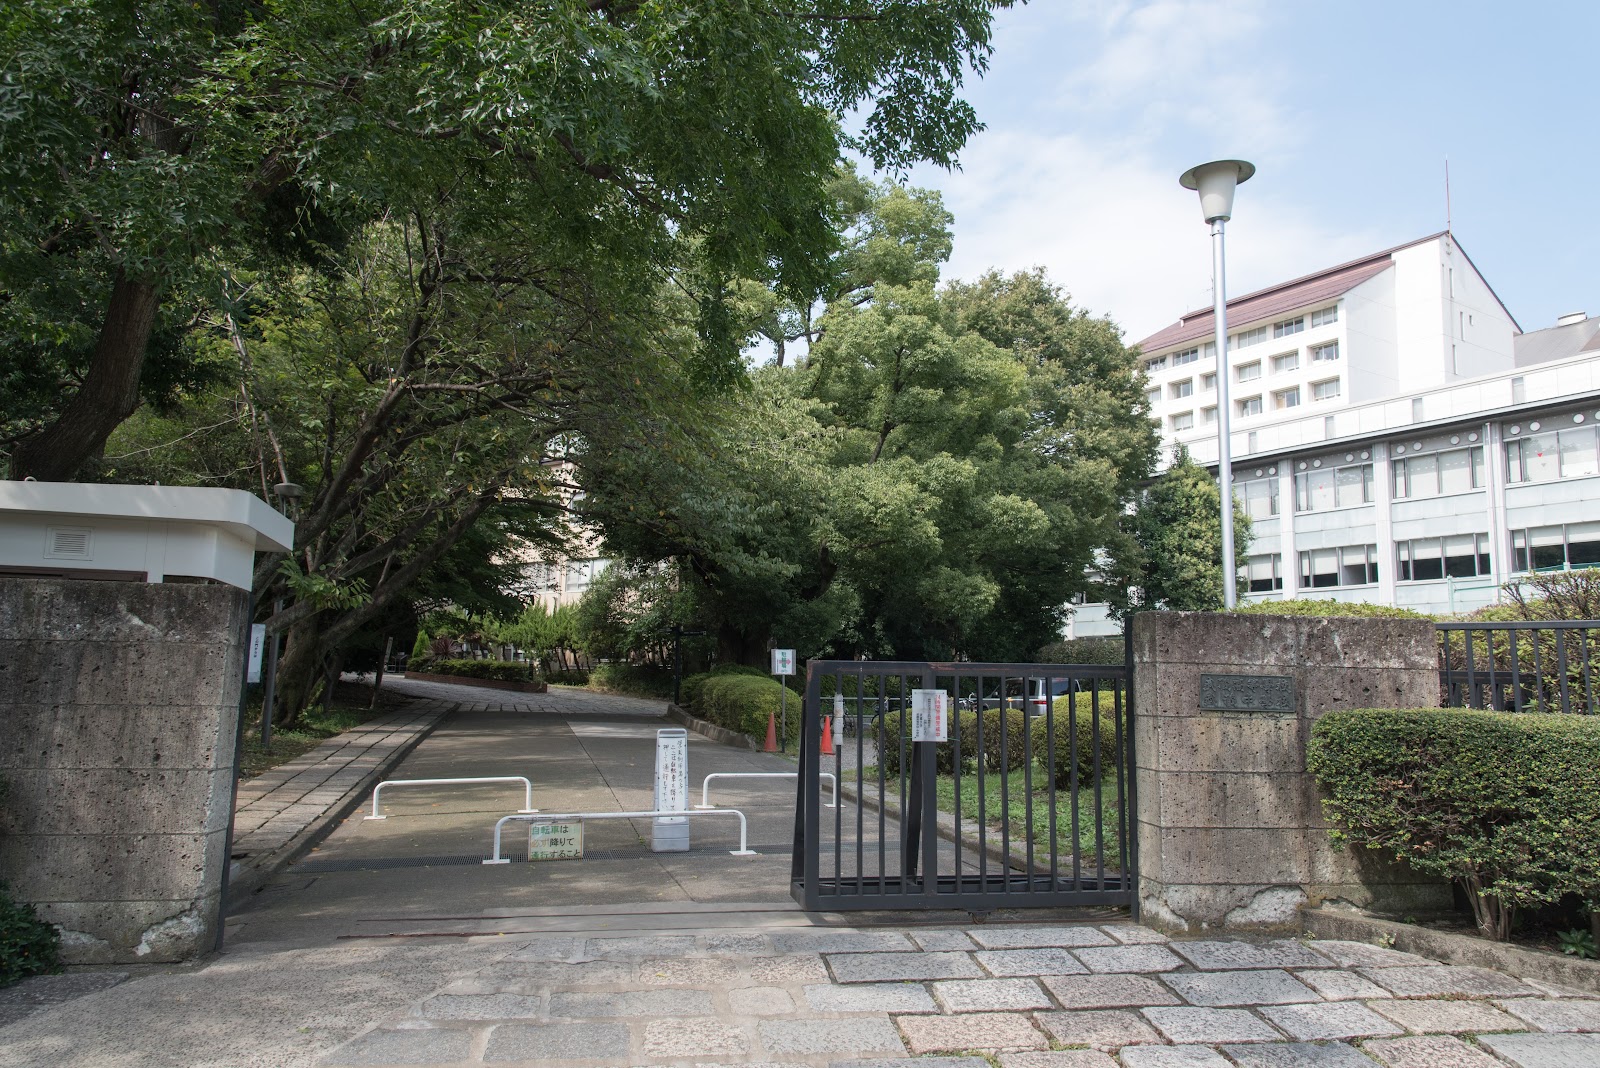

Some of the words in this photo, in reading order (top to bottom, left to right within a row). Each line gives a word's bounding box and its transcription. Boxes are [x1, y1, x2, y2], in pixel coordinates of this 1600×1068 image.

[532, 825, 569, 835] 自転車は
[531, 849, 580, 859] 通行すること
